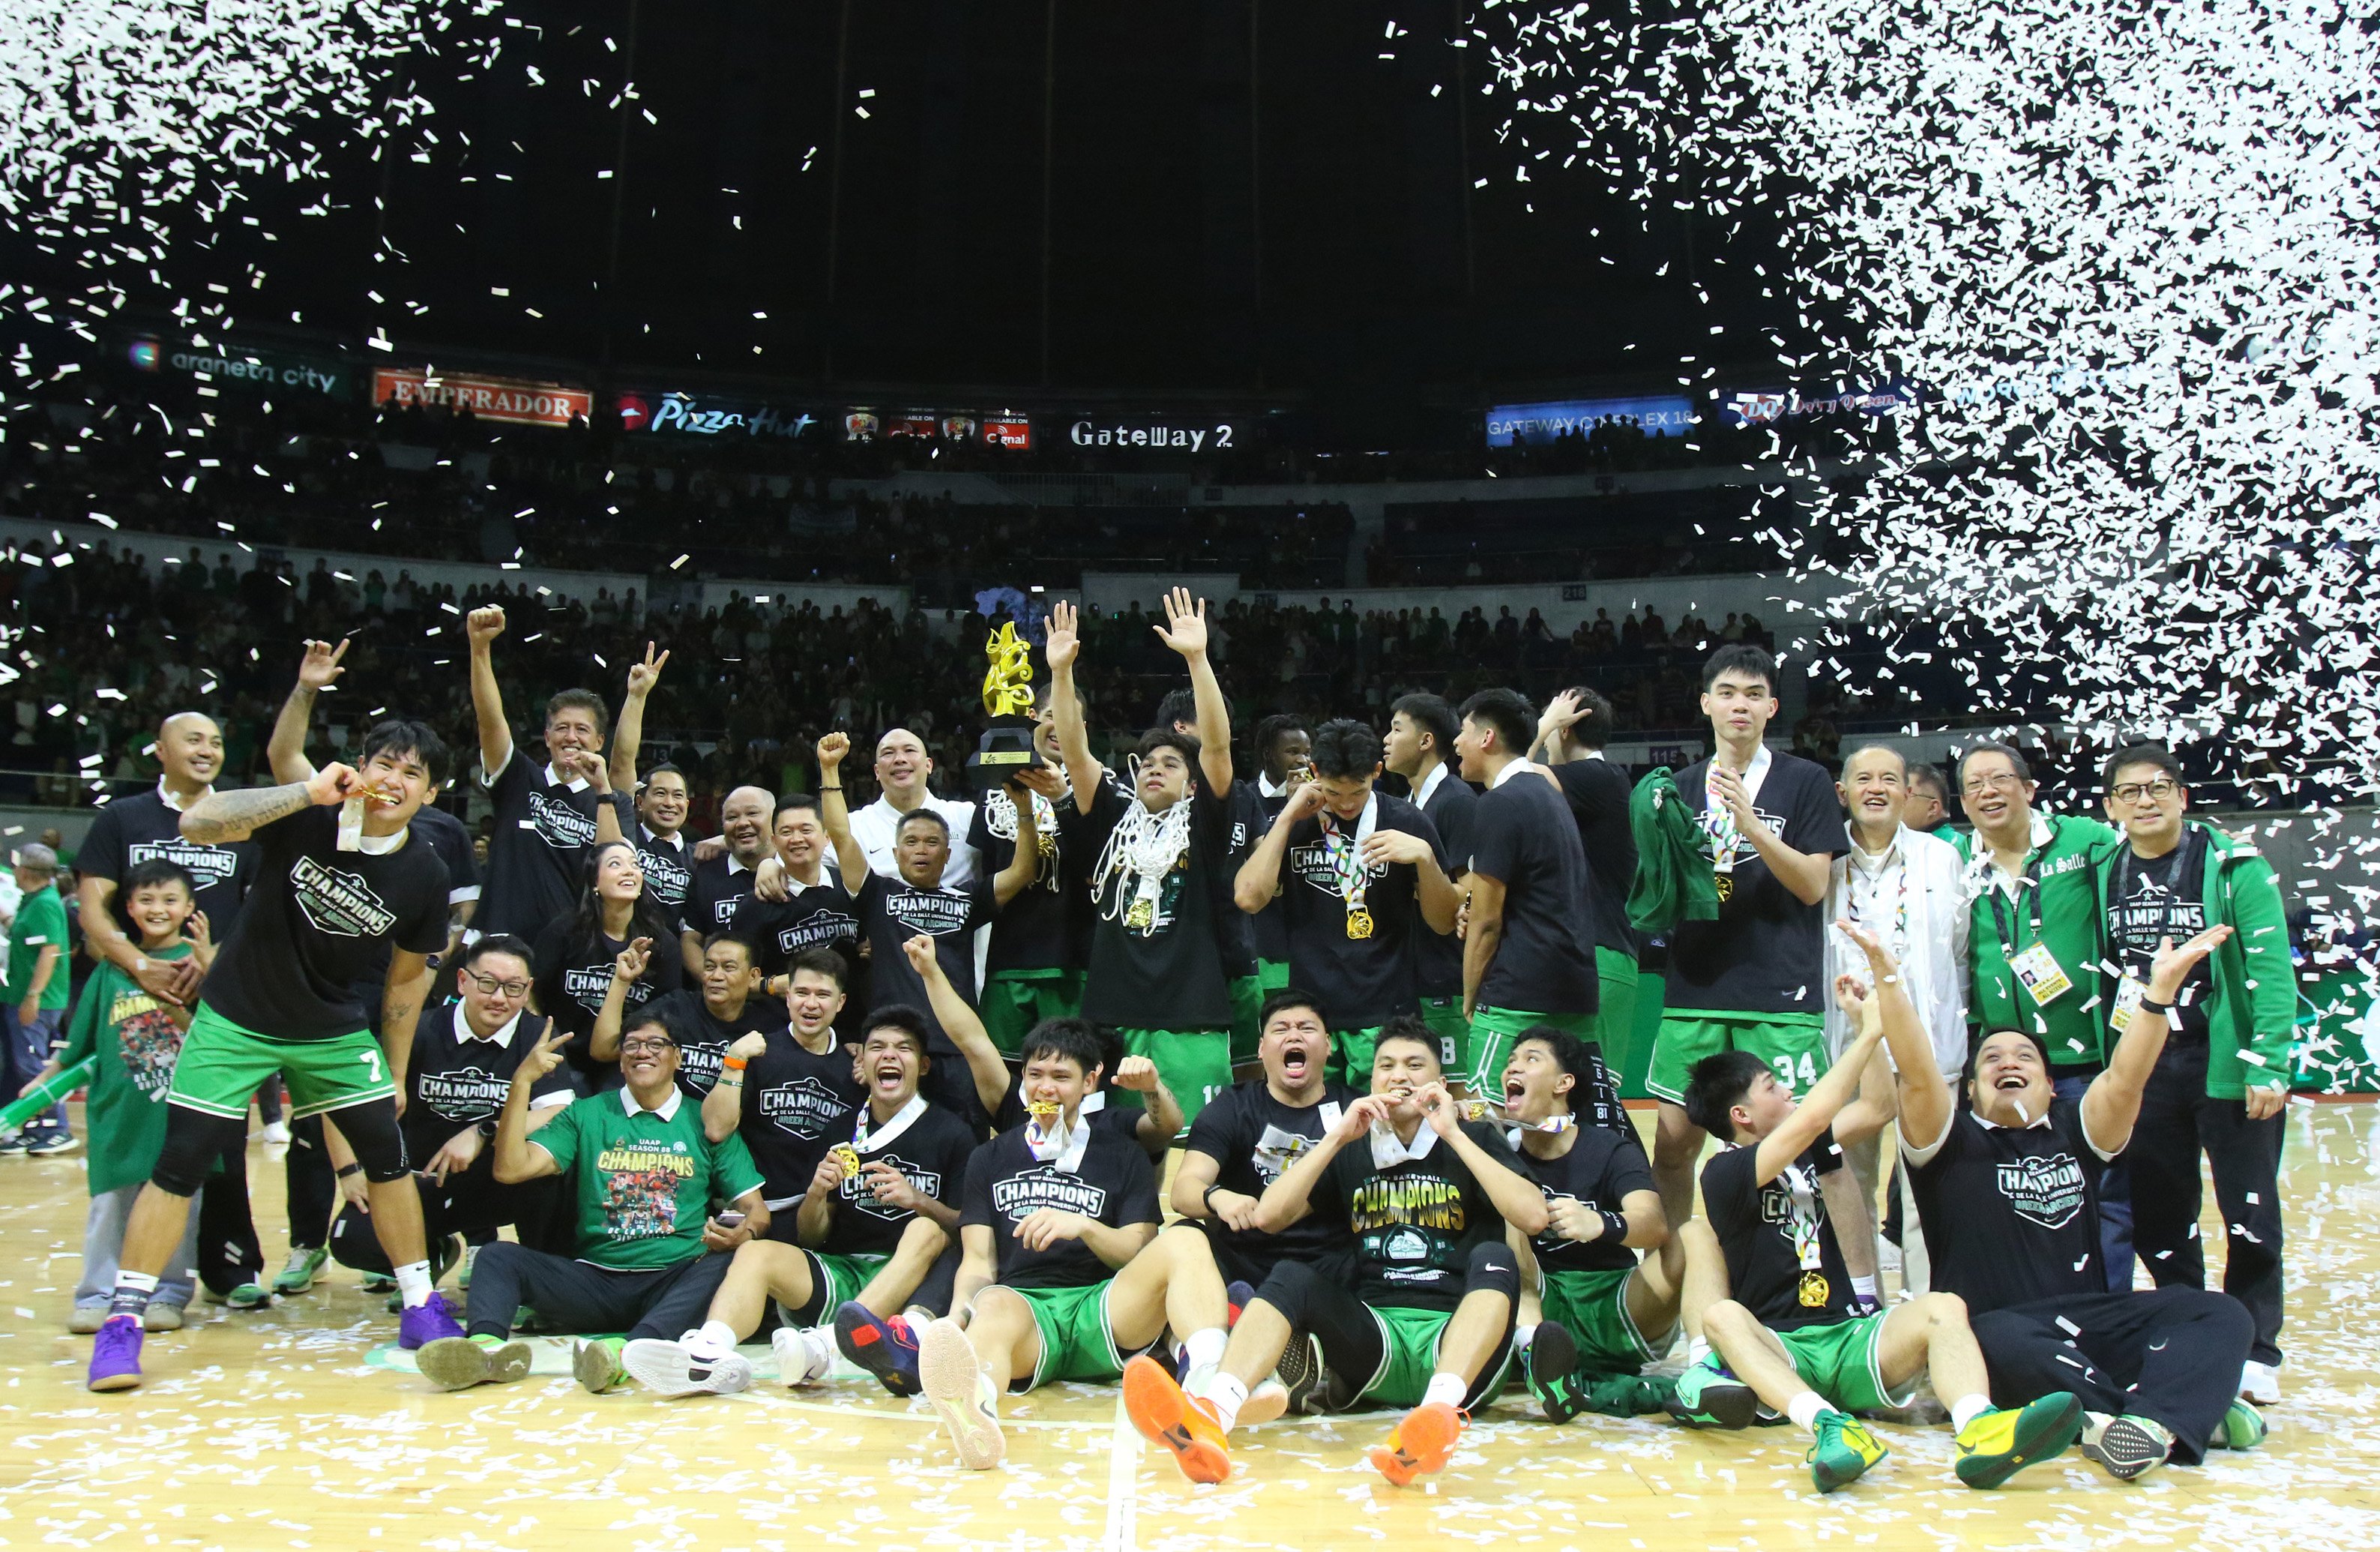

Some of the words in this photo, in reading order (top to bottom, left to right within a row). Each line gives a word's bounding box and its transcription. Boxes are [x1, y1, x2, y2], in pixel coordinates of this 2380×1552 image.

[283, 365, 336, 394] city
[394, 380, 572, 418] EMPERADOR
[1747, 401, 1780, 421] DQ
[651, 397, 746, 433] Pizza
[748, 407, 818, 438] Hut
[1488, 416, 1576, 436] GATEWAY
[1673, 410, 1693, 424] 18
[1216, 424, 1233, 448] 2
[1651, 751, 1679, 765] 115
[2040, 861, 2054, 878] La
[2055, 852, 2086, 874] Salle
[295, 861, 391, 932] CHAMPIONS
[888, 897, 971, 919] CHAMPIONS
[931, 913, 958, 921] UNIVERSITY
[359, 1049, 382, 1083] 7
[1773, 1051, 1817, 1090] 34
[628, 1144, 660, 1152] SEASON
[660, 1145, 671, 1153] 88
[597, 1150, 695, 1180] CHAMPIONS
[997, 1182, 1100, 1212] CHAMPIONS
[1047, 1200, 1079, 1212] UNIVERSITY
[1351, 1179, 1465, 1234] CHAMPIONS
